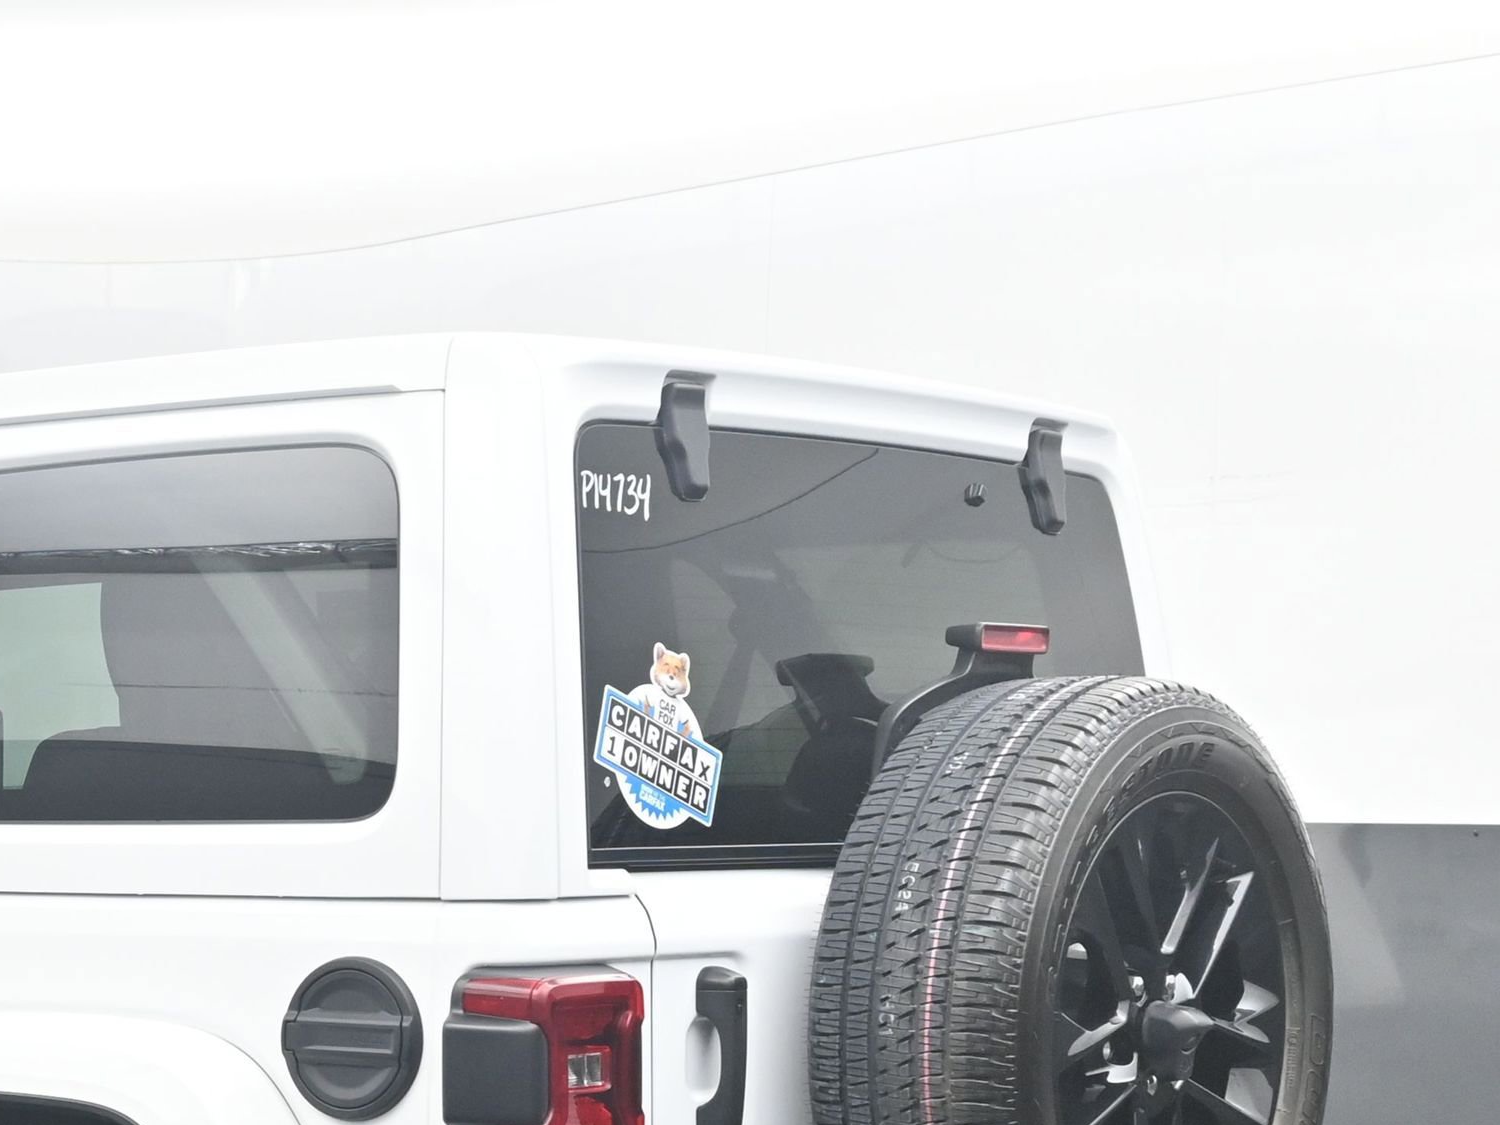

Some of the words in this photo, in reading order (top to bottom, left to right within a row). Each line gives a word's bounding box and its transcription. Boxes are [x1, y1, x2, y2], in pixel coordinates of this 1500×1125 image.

[580, 469, 652, 522] P14734
[658, 711, 674, 728] FOX
[659, 699, 677, 716] CAR
[611, 704, 711, 782] CARFAX
[606, 735, 617, 757] 1
[623, 745, 708, 810] OWNER
